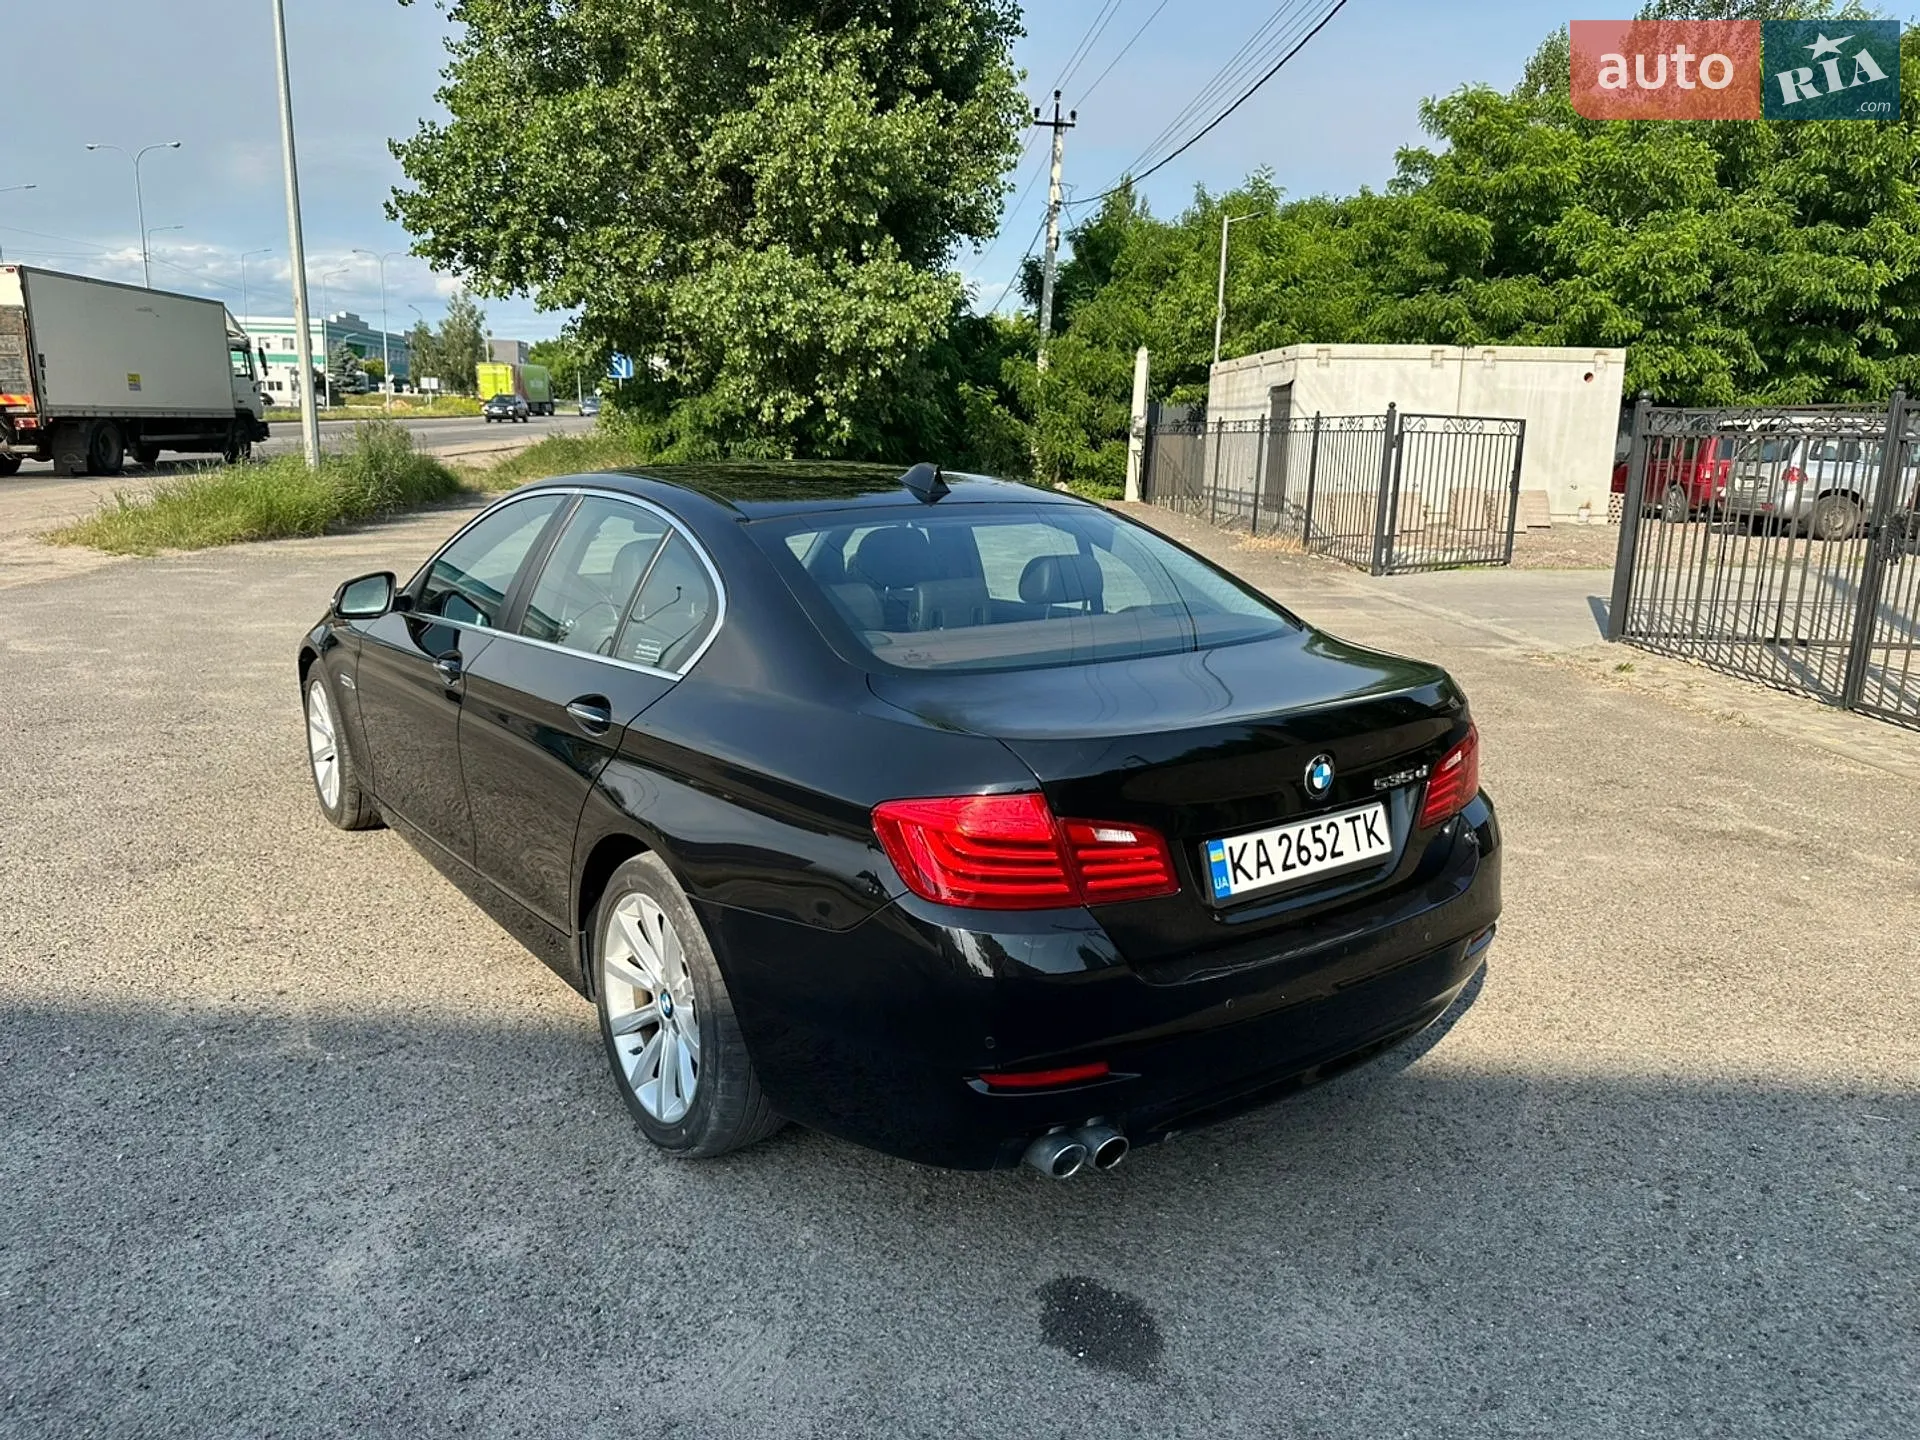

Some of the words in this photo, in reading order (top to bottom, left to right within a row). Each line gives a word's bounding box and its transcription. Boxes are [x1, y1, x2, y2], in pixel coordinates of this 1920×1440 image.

[1228, 838, 1275, 885] KA
[1279, 821, 1344, 873] 2652
[1344, 809, 1385, 853] TK
[1214, 875, 1229, 890] UA
